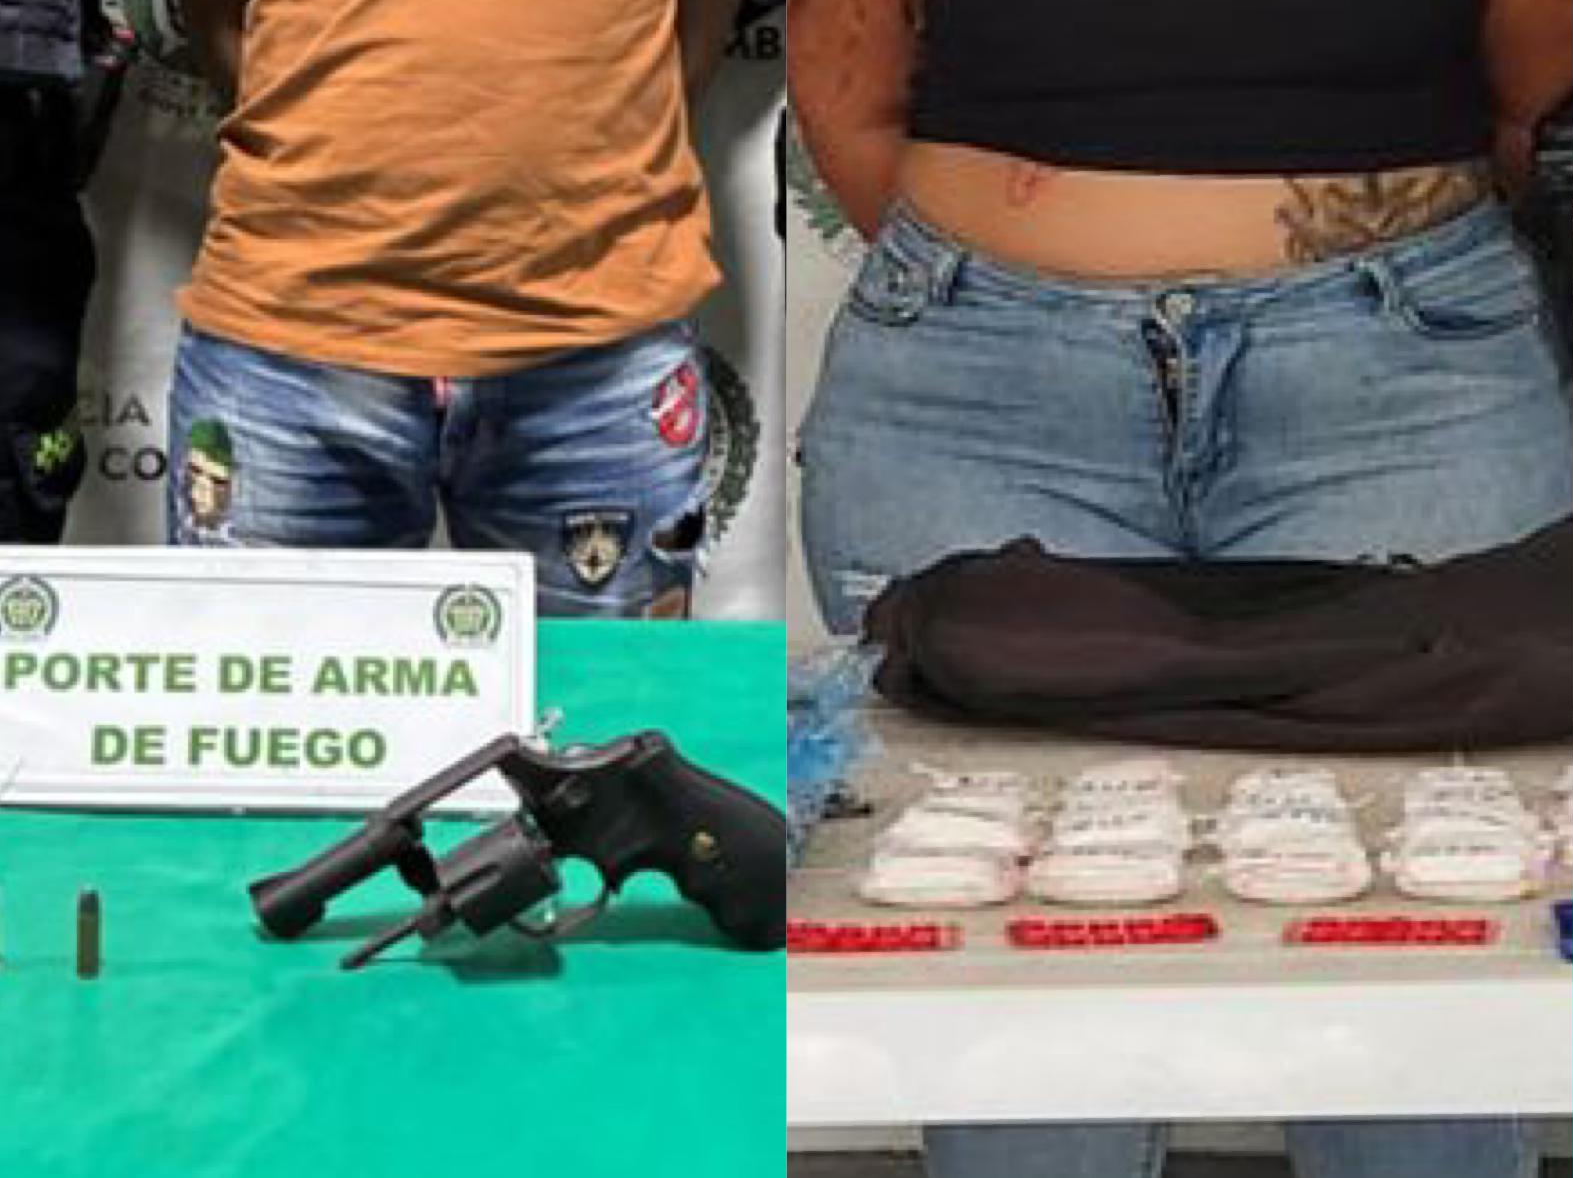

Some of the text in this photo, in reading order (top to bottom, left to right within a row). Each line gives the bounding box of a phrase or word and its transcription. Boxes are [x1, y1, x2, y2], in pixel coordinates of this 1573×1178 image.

[4, 653, 479, 697] PORTE DE ARMA
[91, 726, 387, 769] DE FUEGO
